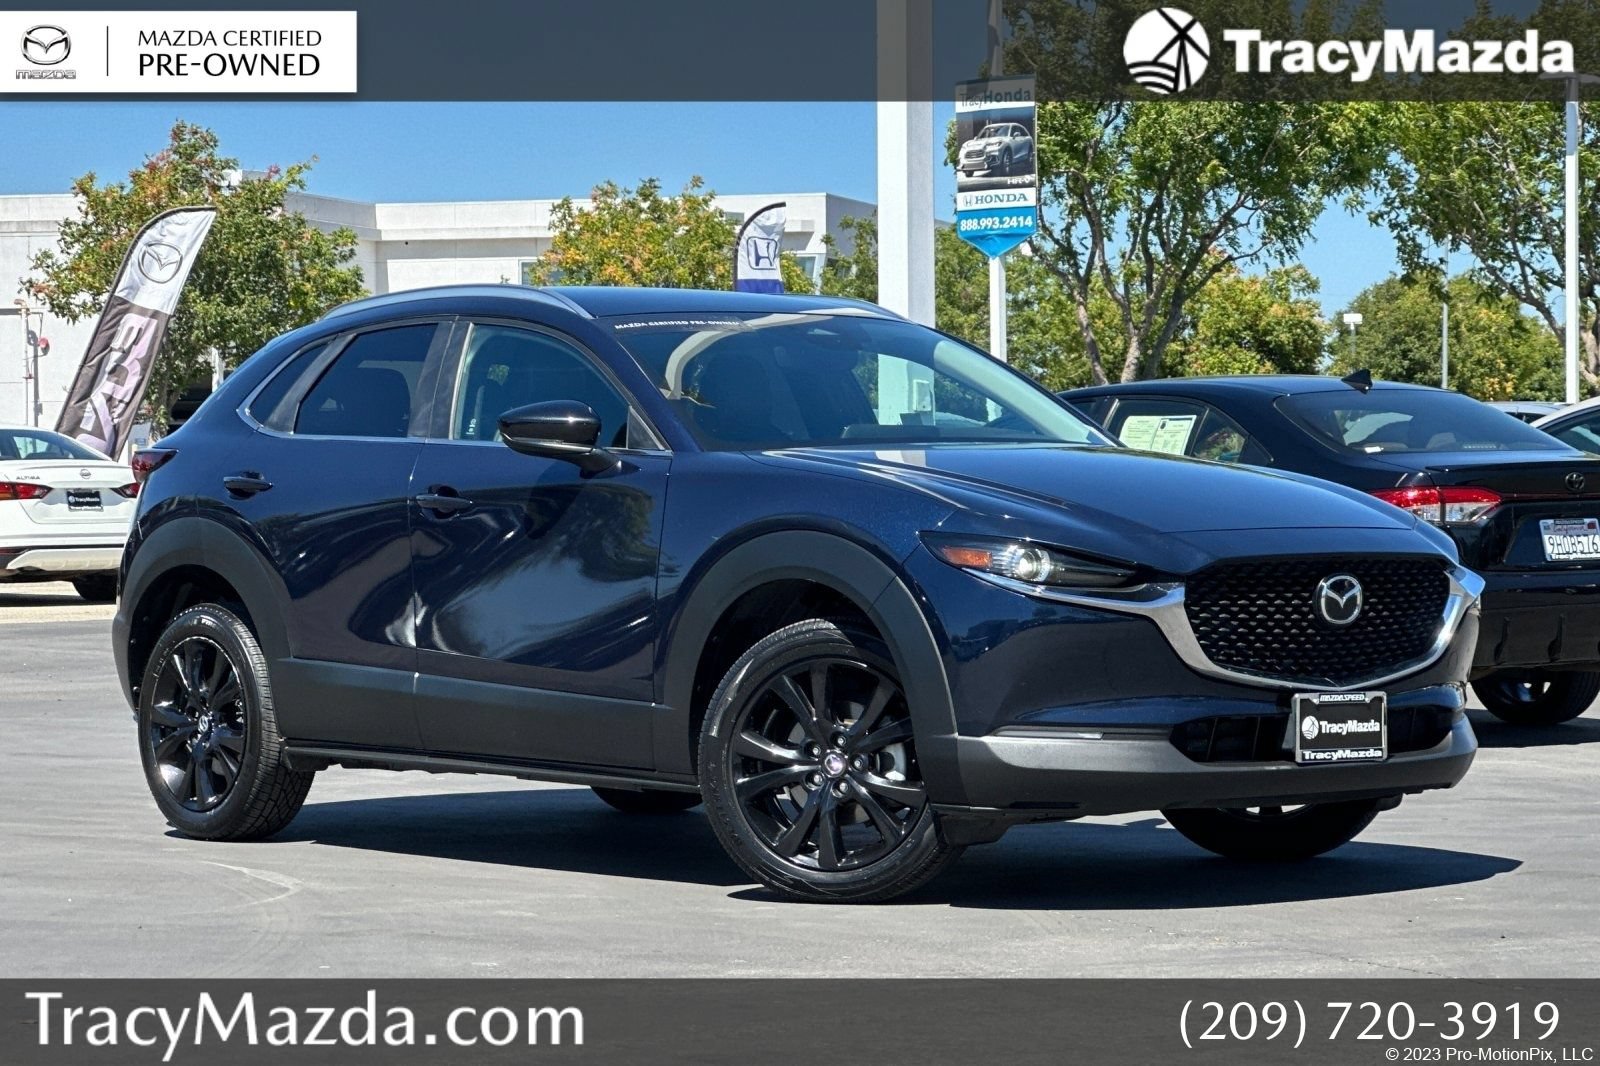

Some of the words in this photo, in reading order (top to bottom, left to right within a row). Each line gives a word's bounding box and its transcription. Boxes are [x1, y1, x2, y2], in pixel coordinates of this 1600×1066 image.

[975, 193, 1028, 205] HONDA
[960, 215, 1033, 232] 888.993.2414
[1320, 720, 1380, 735] TracyMazda
[1303, 749, 1383, 760] TracyMazda
